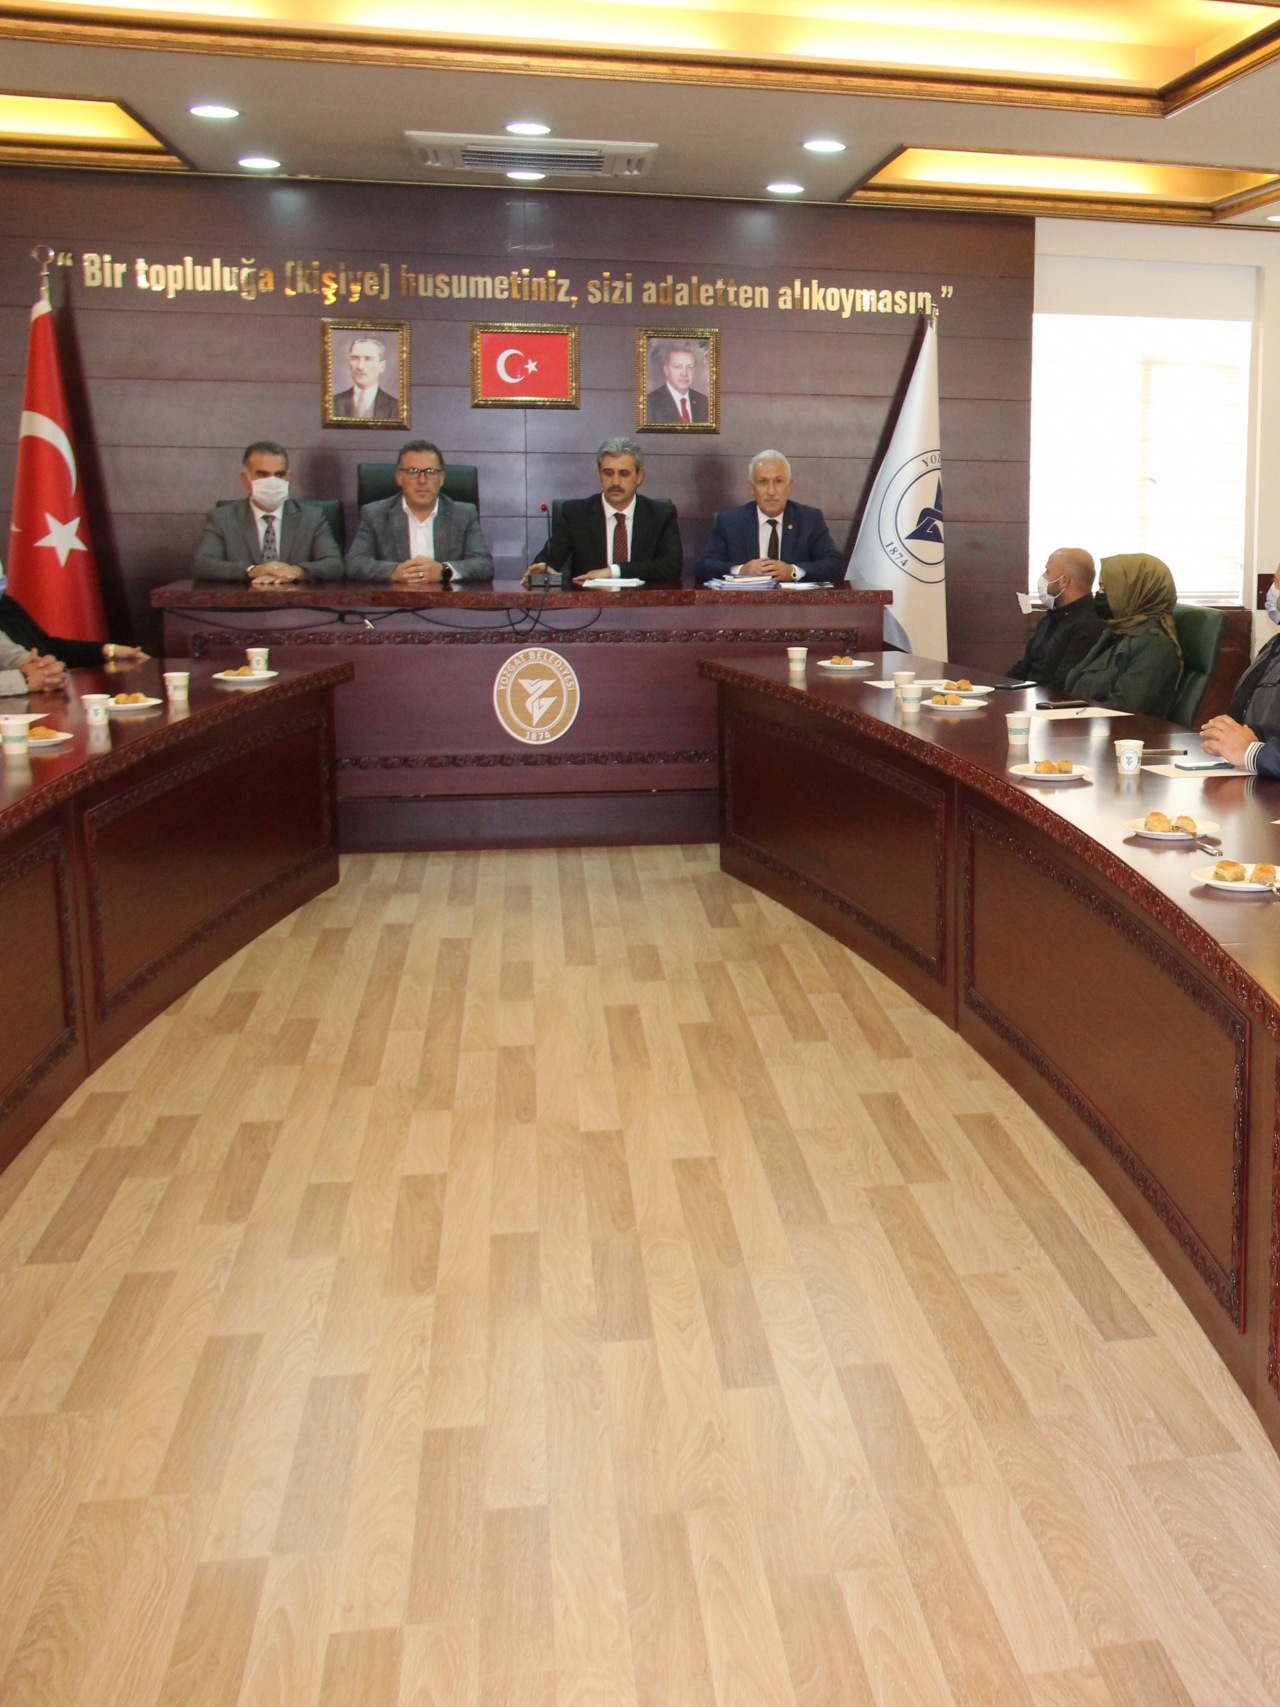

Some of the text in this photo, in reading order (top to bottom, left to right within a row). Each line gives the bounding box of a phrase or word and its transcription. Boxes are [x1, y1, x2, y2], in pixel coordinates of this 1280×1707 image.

[135, 256, 275, 300] topluluğa
[400, 264, 578, 308] husumetiniz,
[587, 271, 633, 304] sizi
[642, 274, 769, 309] adaletten
[885, 541, 909, 567] 1874
[498, 653, 526, 691] YOZGAT
